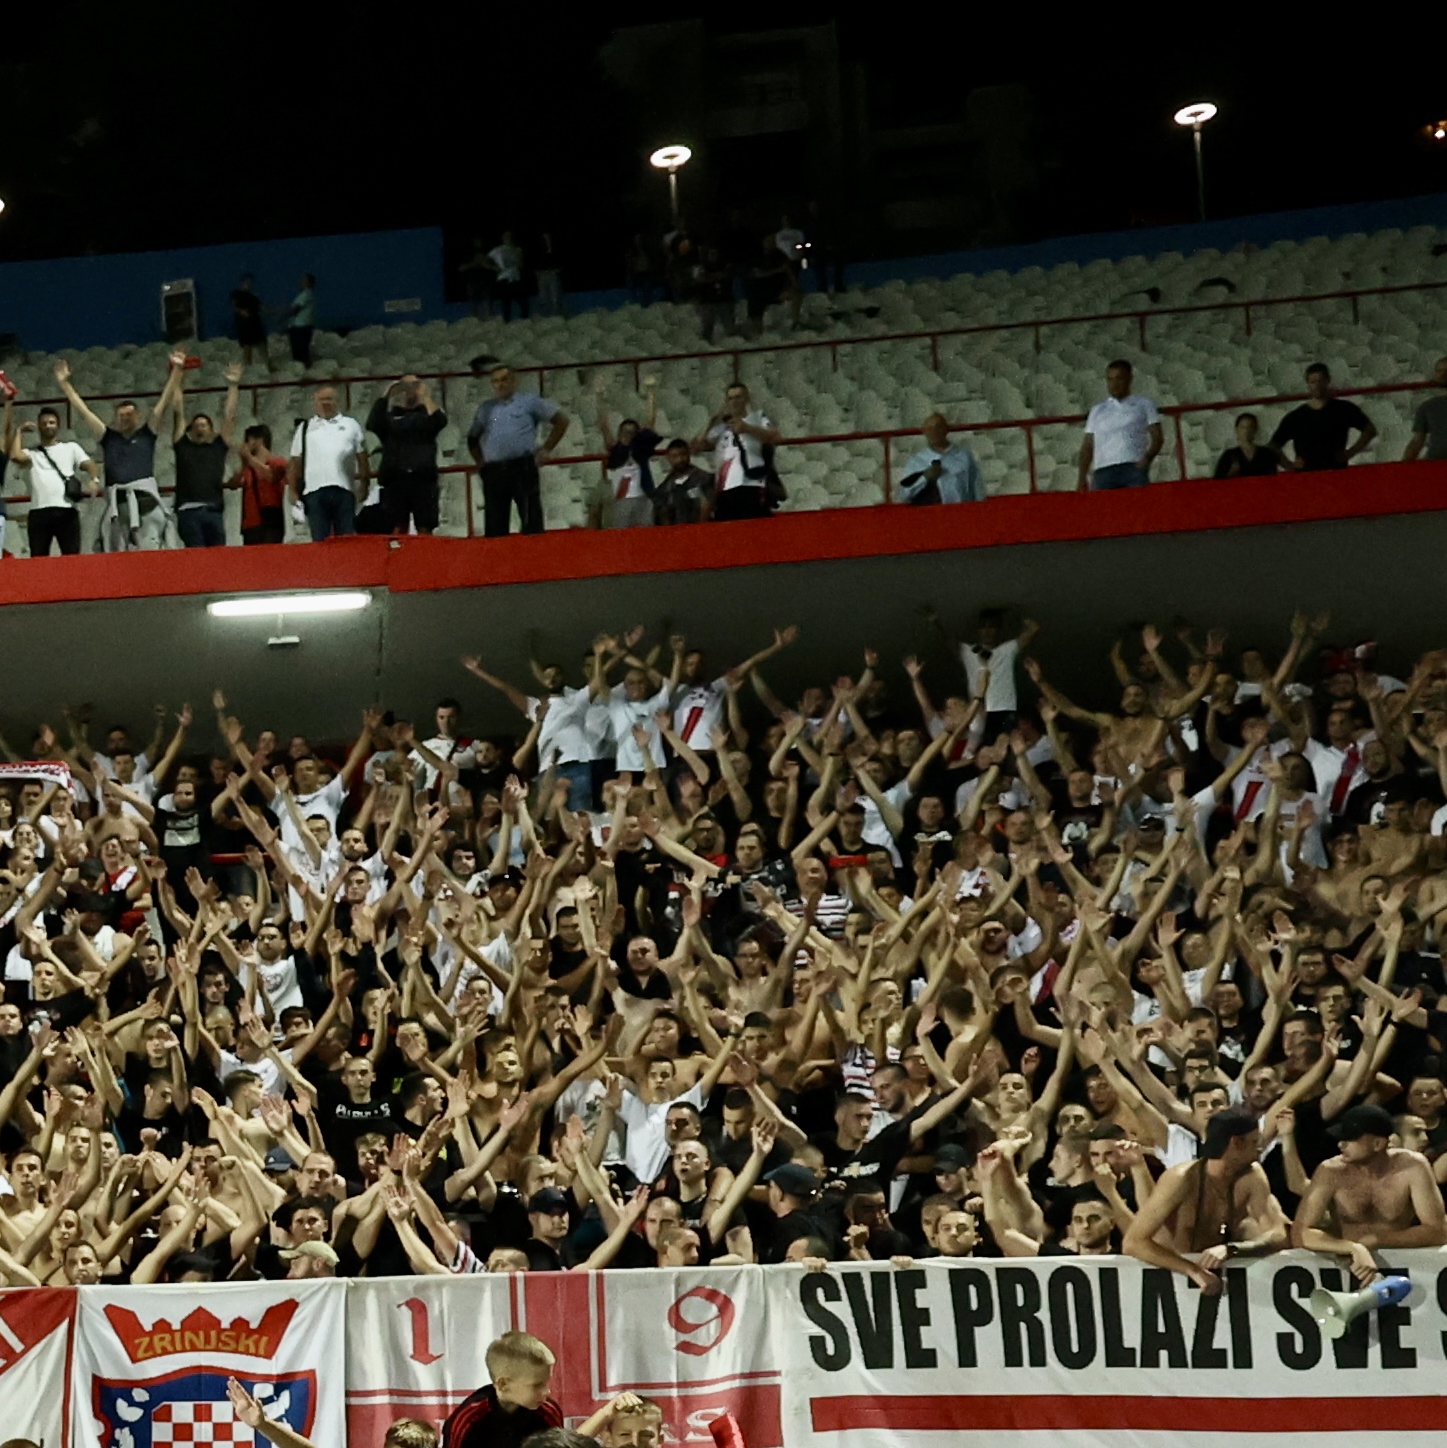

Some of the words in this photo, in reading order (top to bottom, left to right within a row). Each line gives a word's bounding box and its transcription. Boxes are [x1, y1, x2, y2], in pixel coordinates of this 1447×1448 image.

[134, 1329, 269, 1359] ZRINJSKI
[667, 1285, 735, 1356] 9
[800, 1266, 937, 1371] SVE
[949, 1265, 1253, 1370] PROLAZI
